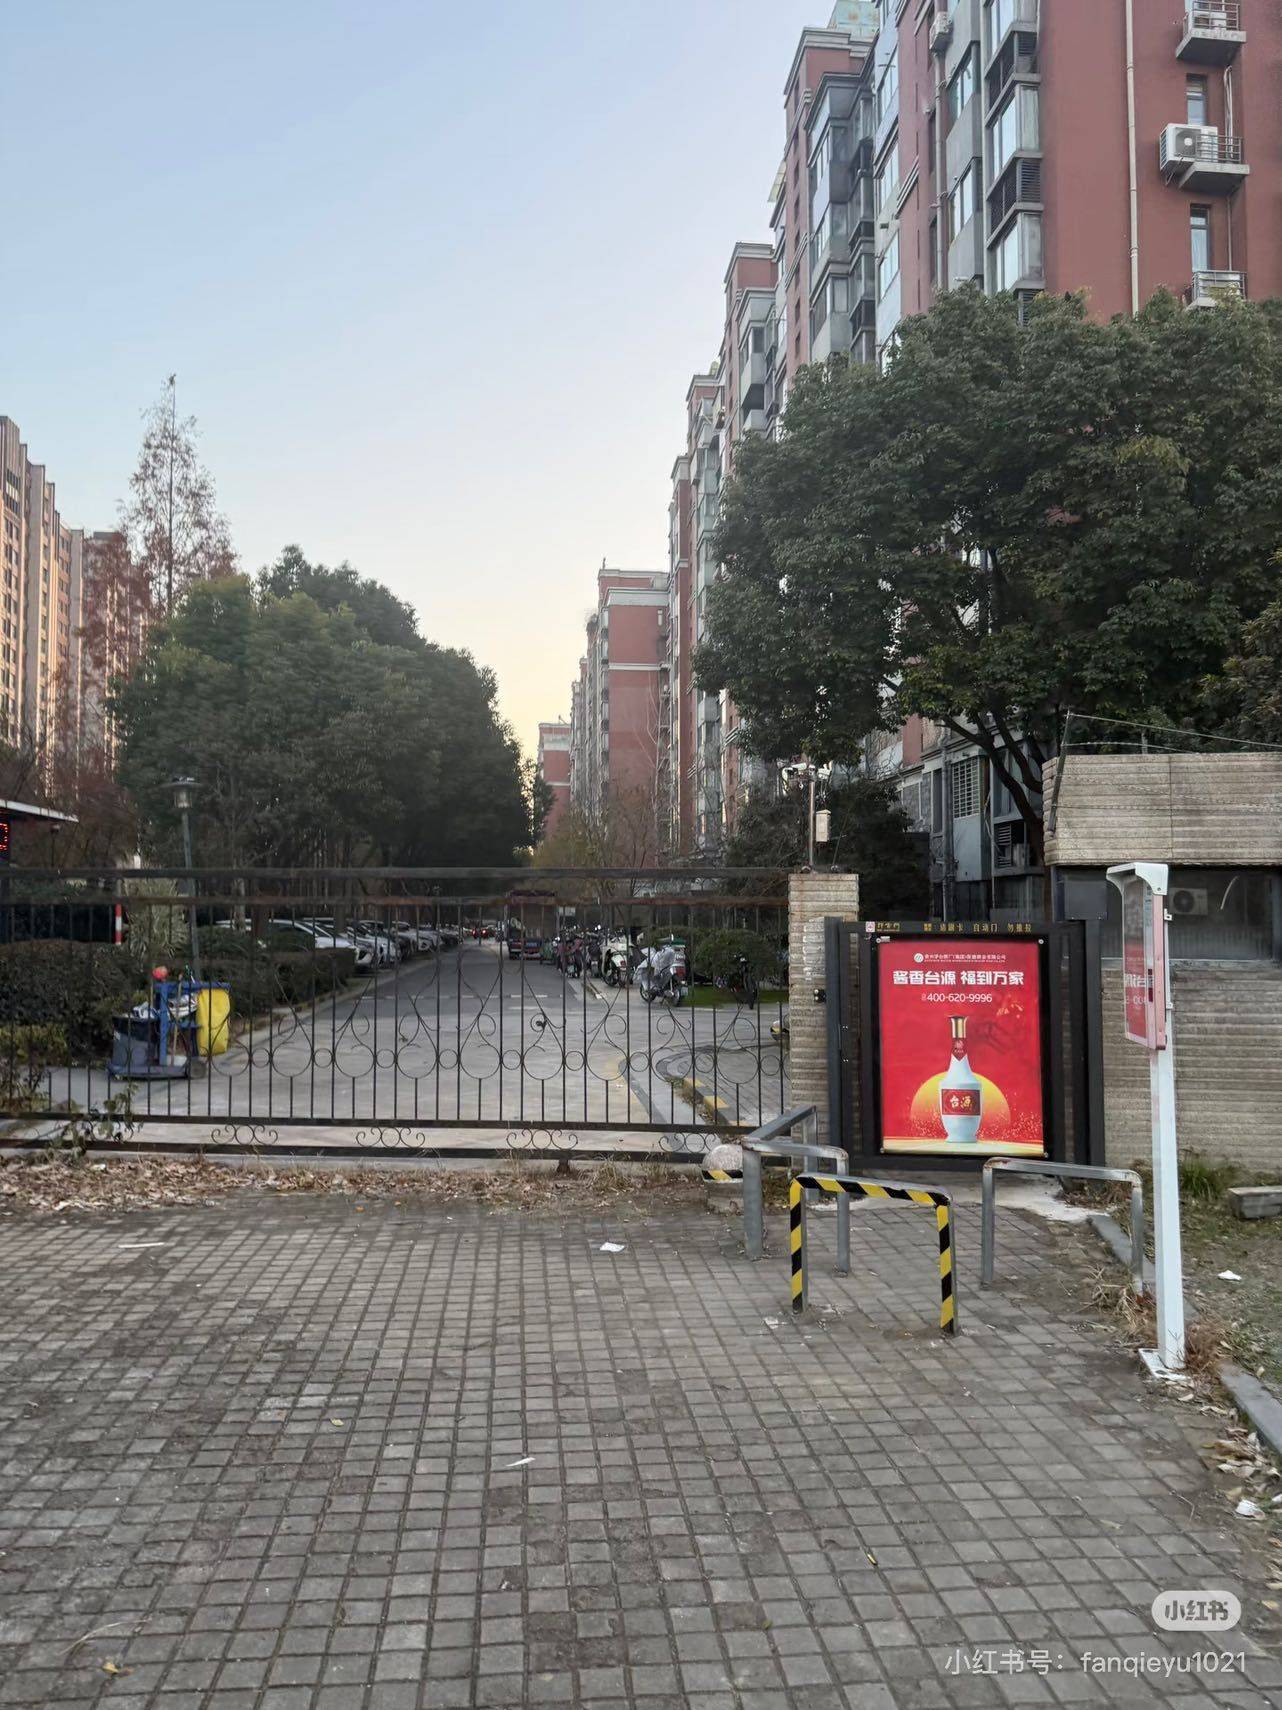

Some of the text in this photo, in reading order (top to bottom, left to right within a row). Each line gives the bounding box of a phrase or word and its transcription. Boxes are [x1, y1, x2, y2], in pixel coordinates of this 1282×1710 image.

[973, 922, 998, 933] 自动门
[893, 970, 1024, 985] 酱香台源 福到万家
[927, 993, 992, 1003] 400-620-9996
